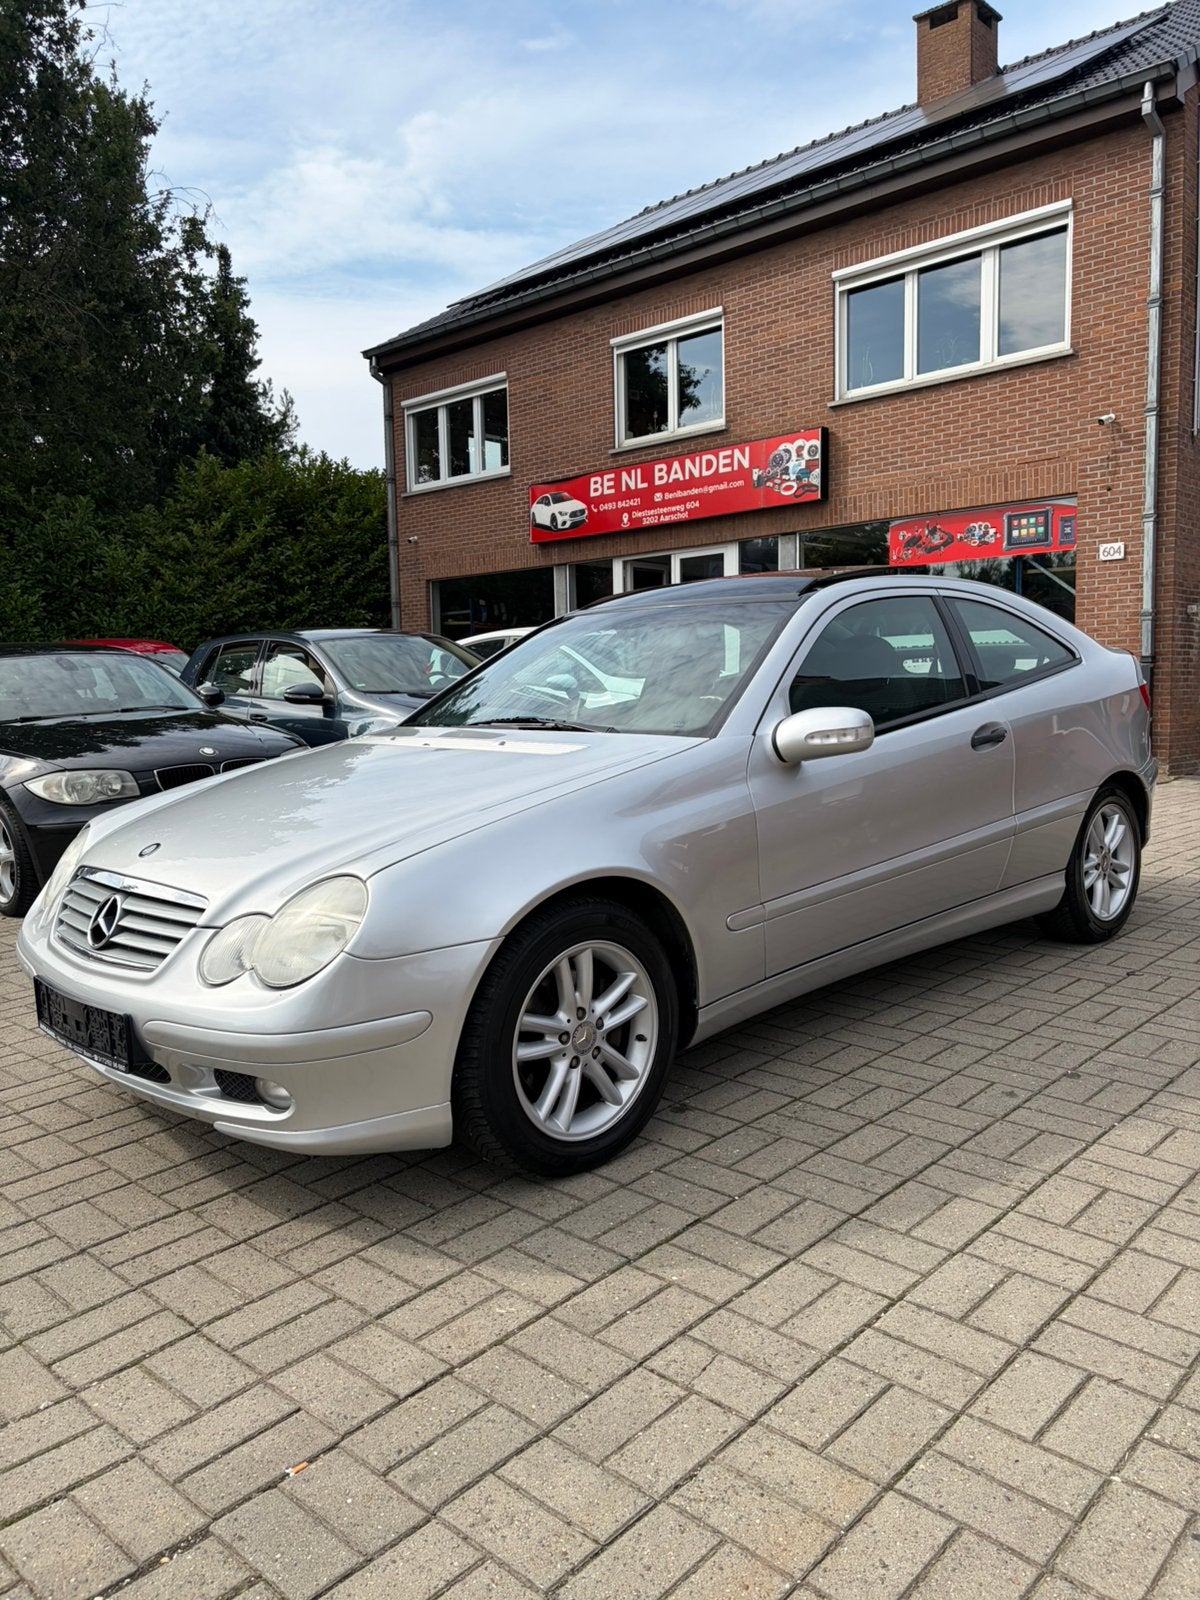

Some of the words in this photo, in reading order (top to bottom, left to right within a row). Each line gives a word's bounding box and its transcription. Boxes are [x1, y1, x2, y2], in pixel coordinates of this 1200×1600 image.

[590, 473, 615, 497] BE
[621, 468, 648, 492] NL
[654, 446, 750, 485] BANDEN
[599, 502, 616, 512] 0493
[617, 498, 641, 509] 842421
[632, 504, 685, 518] Diestsesteenweg
[686, 500, 700, 509] 604
[642, 516, 658, 525] 3202
[660, 511, 689, 522] Aarschot
[1102, 545, 1122, 558] 604
